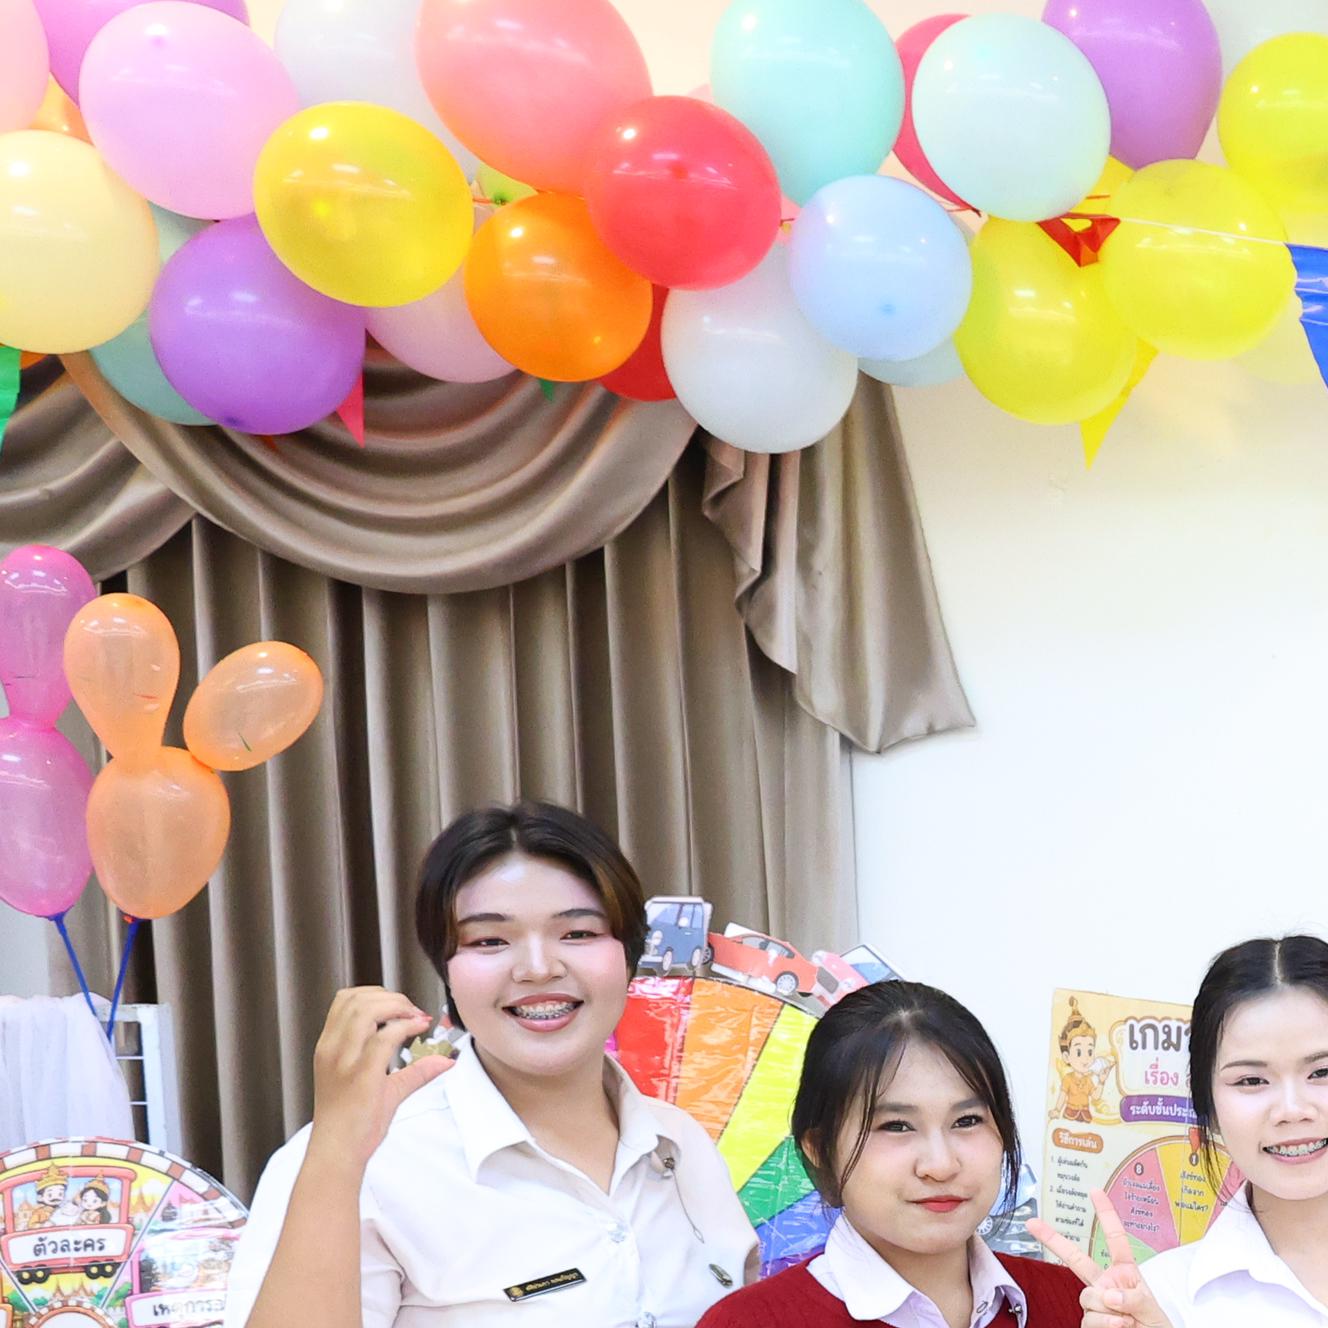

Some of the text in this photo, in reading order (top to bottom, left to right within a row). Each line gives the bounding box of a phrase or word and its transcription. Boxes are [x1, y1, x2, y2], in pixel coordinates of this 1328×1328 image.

[1128, 1021, 1190, 1052] เกม
[1144, 1057, 1179, 1087] เรื่อง
[32, 1232, 107, 1258] ตัวละคร
